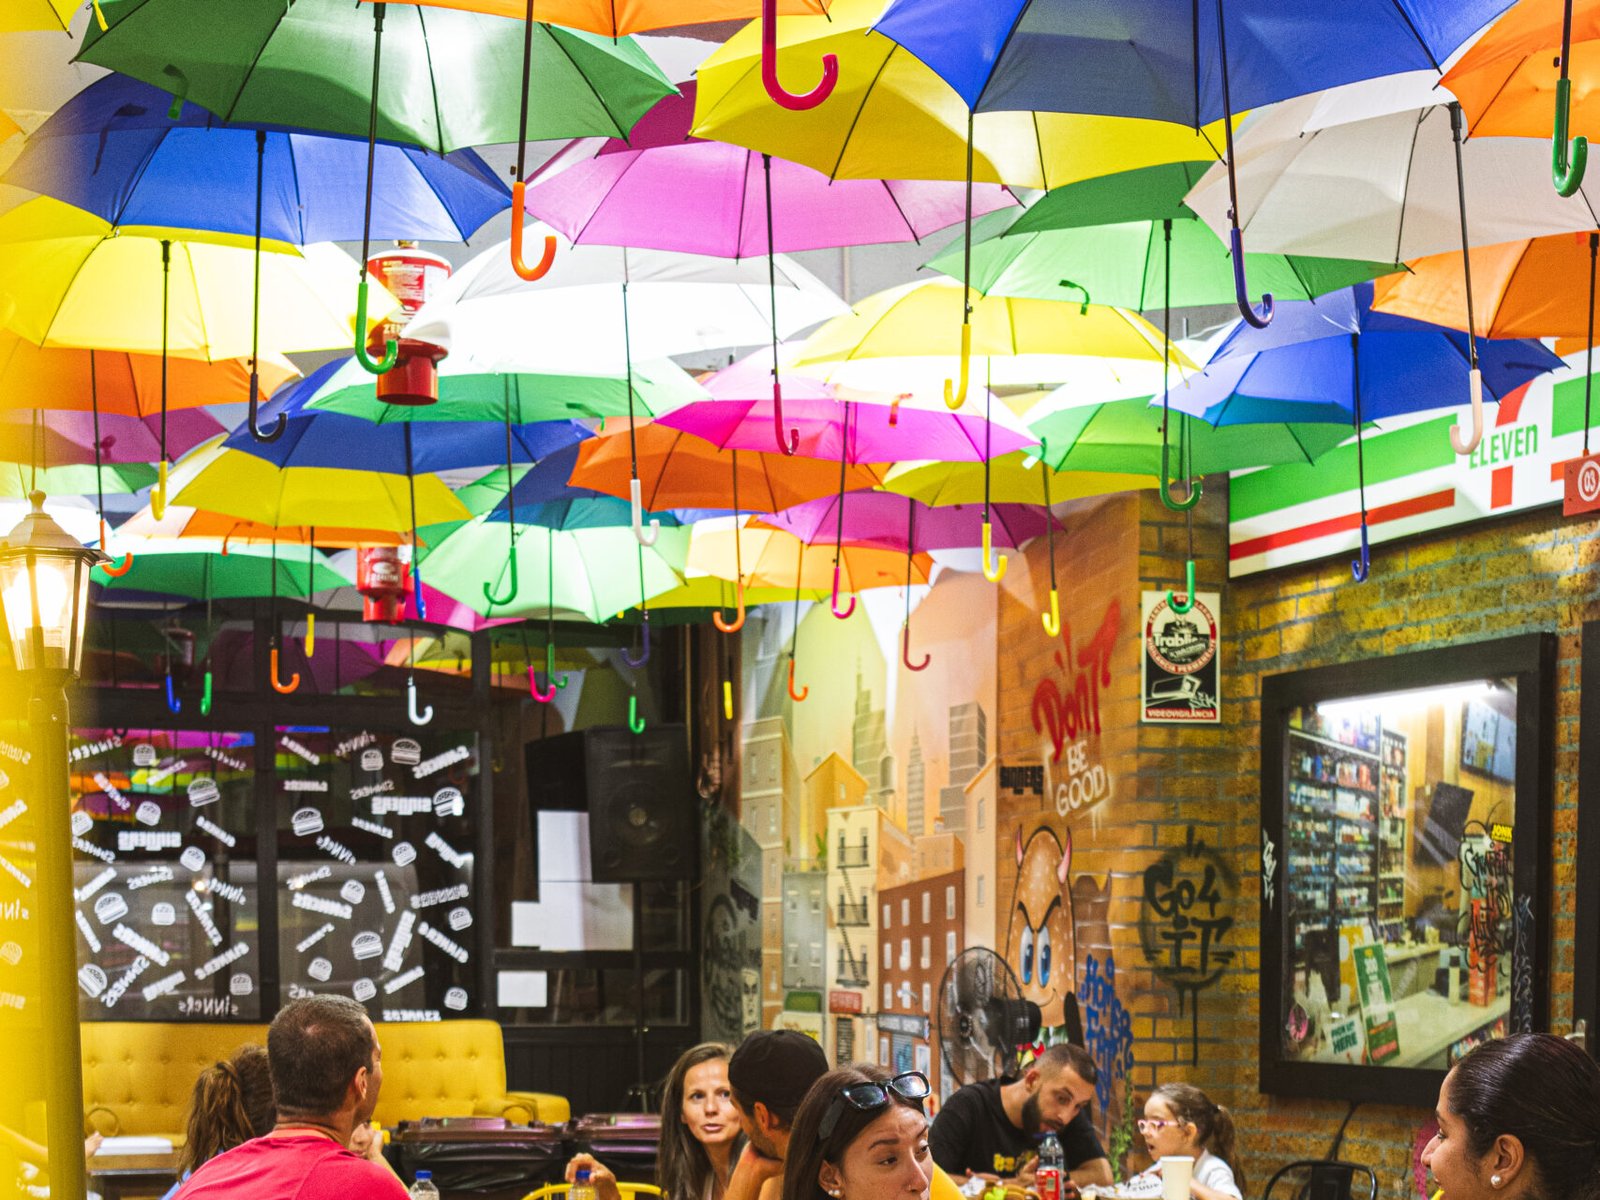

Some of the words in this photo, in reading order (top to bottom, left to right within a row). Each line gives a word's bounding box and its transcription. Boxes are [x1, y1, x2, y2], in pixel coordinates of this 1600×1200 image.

[1067, 741, 1089, 777] BE
[1056, 765, 1105, 817] GOOD
[1333, 1032, 1357, 1054] HERE
